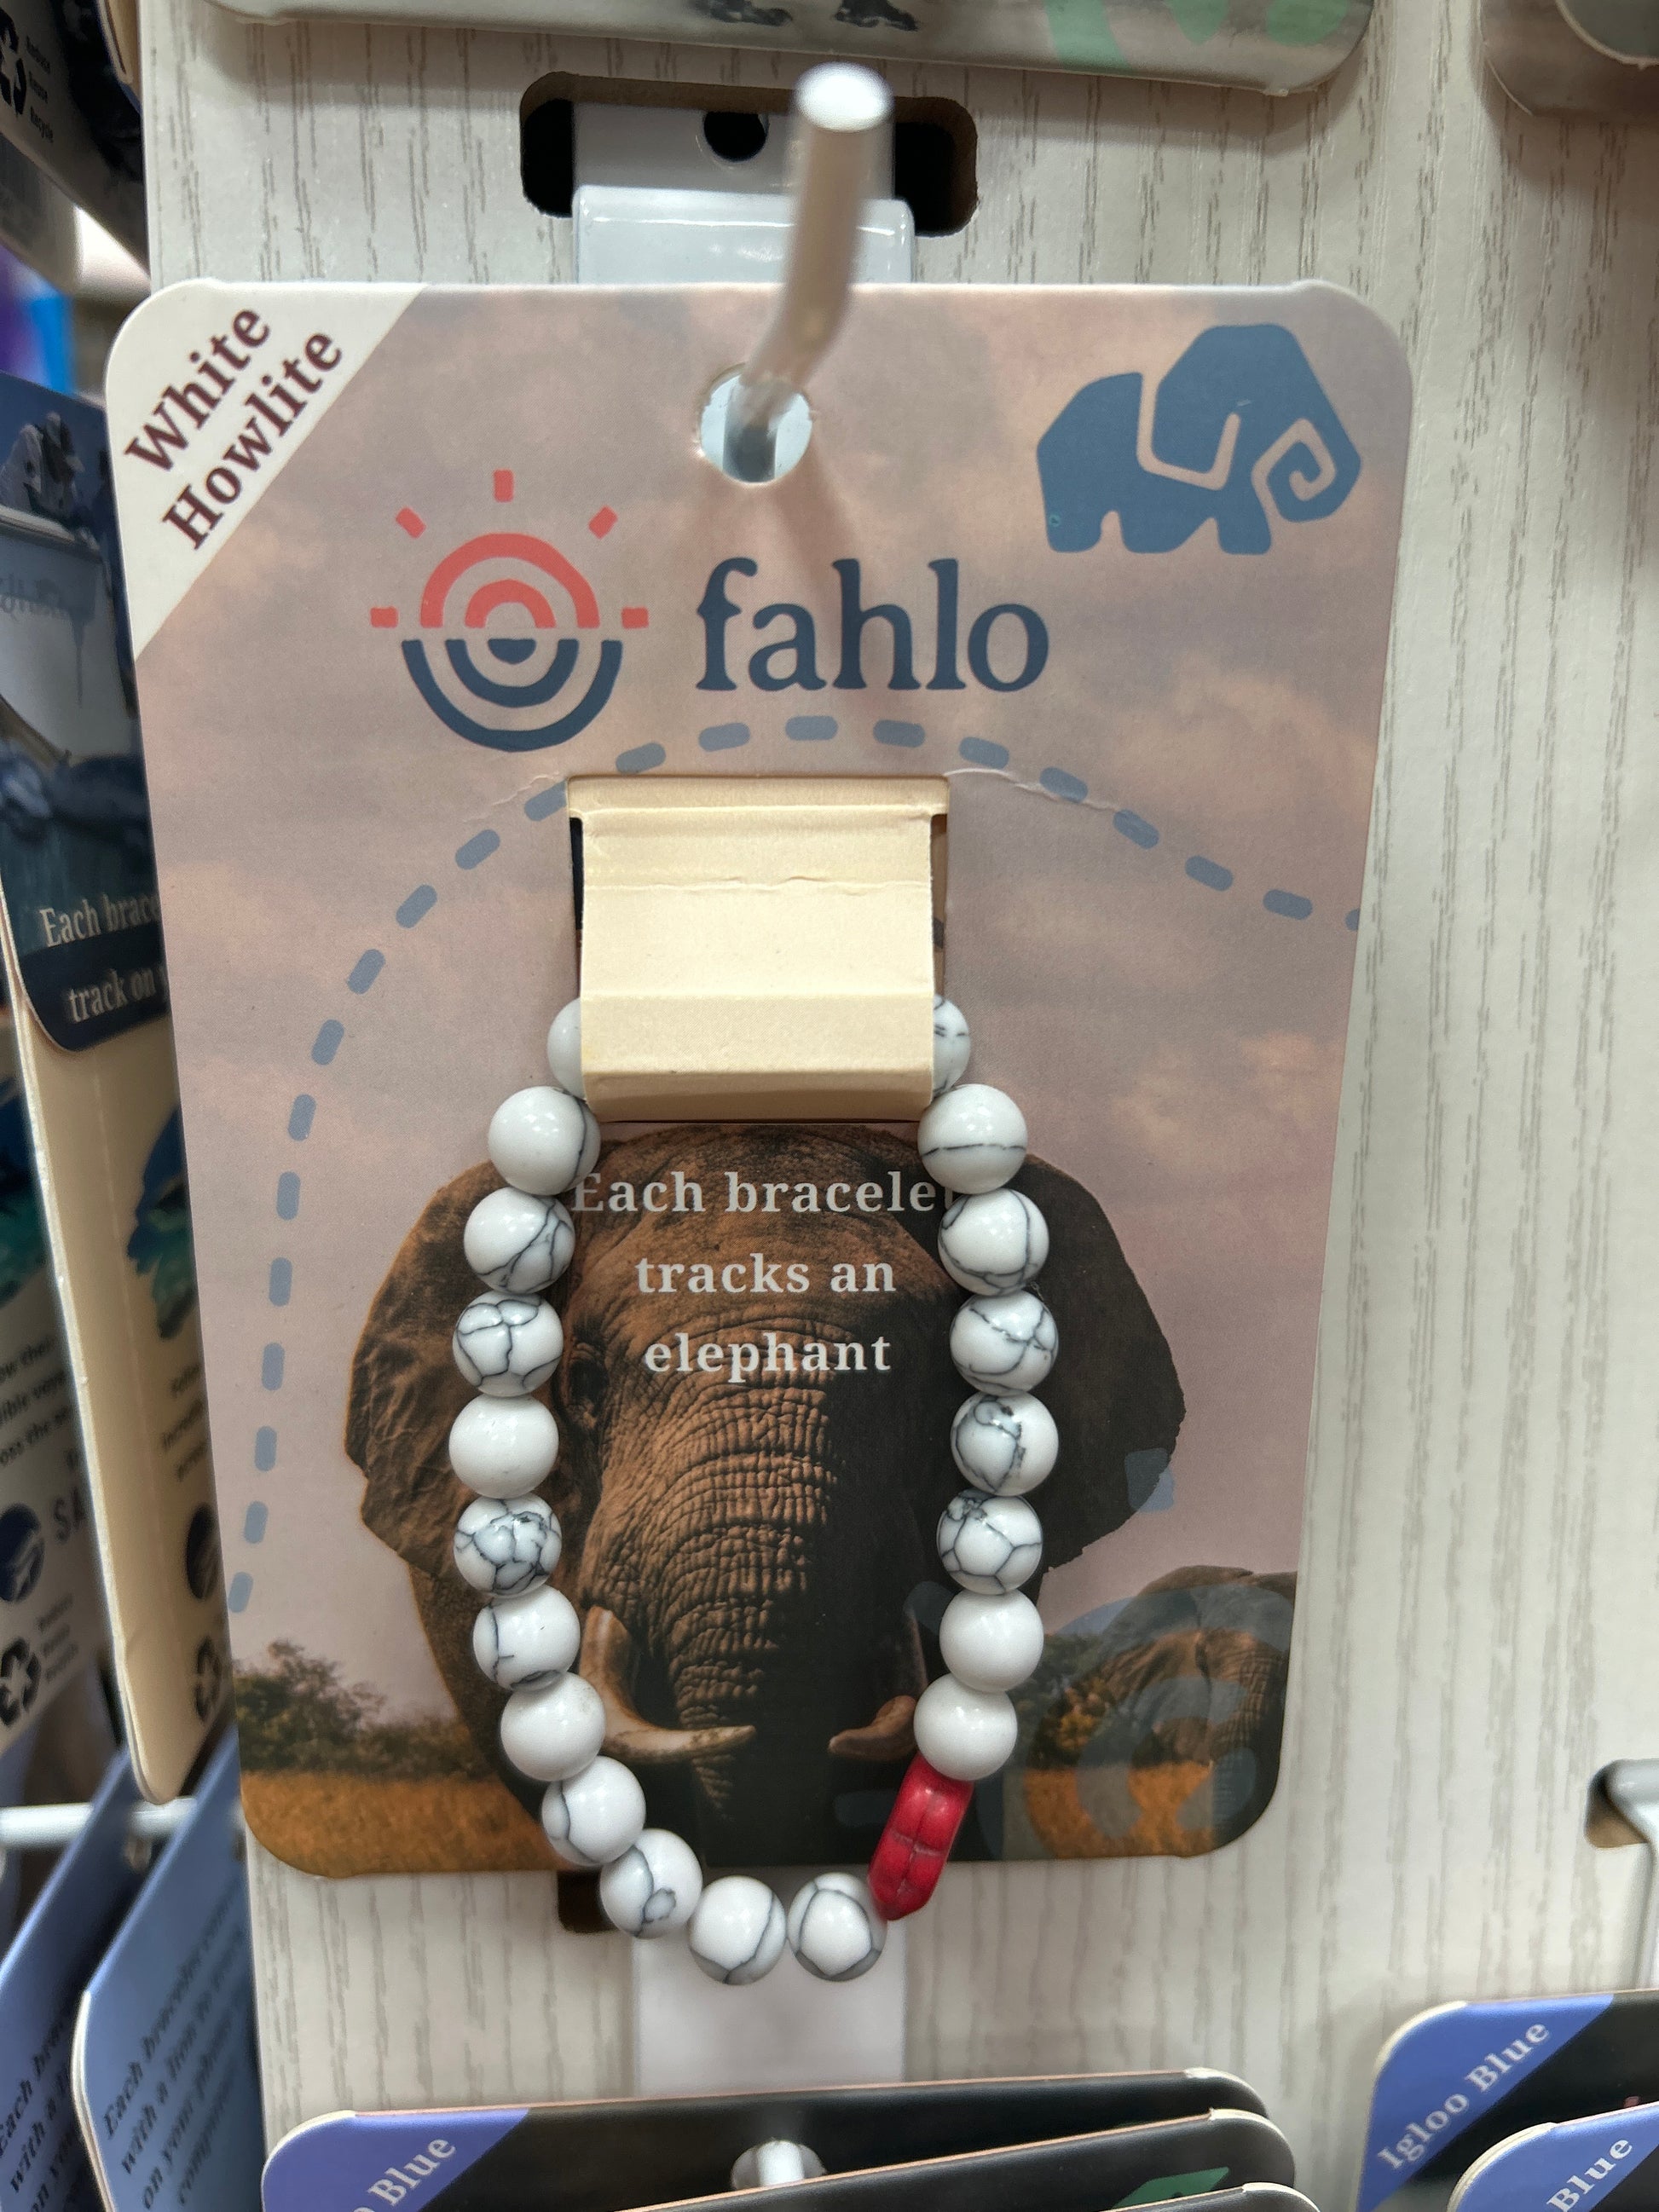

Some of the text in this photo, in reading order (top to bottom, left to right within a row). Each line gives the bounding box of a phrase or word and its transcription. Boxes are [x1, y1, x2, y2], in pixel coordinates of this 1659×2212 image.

[124, 309, 270, 471] White
[161, 333, 342, 551] Howlite
[696, 557, 1049, 692] fahlo
[39, 897, 102, 948] Each
[68, 967, 156, 1024] track on
[571, 1171, 706, 1212] Each
[635, 1252, 897, 1294] tracks an
[645, 1332, 892, 1383] elephant
[104, 2060, 143, 2140] Each
[1377, 2022, 1552, 2171] Igloo Blue
[367, 2139, 456, 2207] Blue
[1546, 2140, 1633, 2212] Blue
